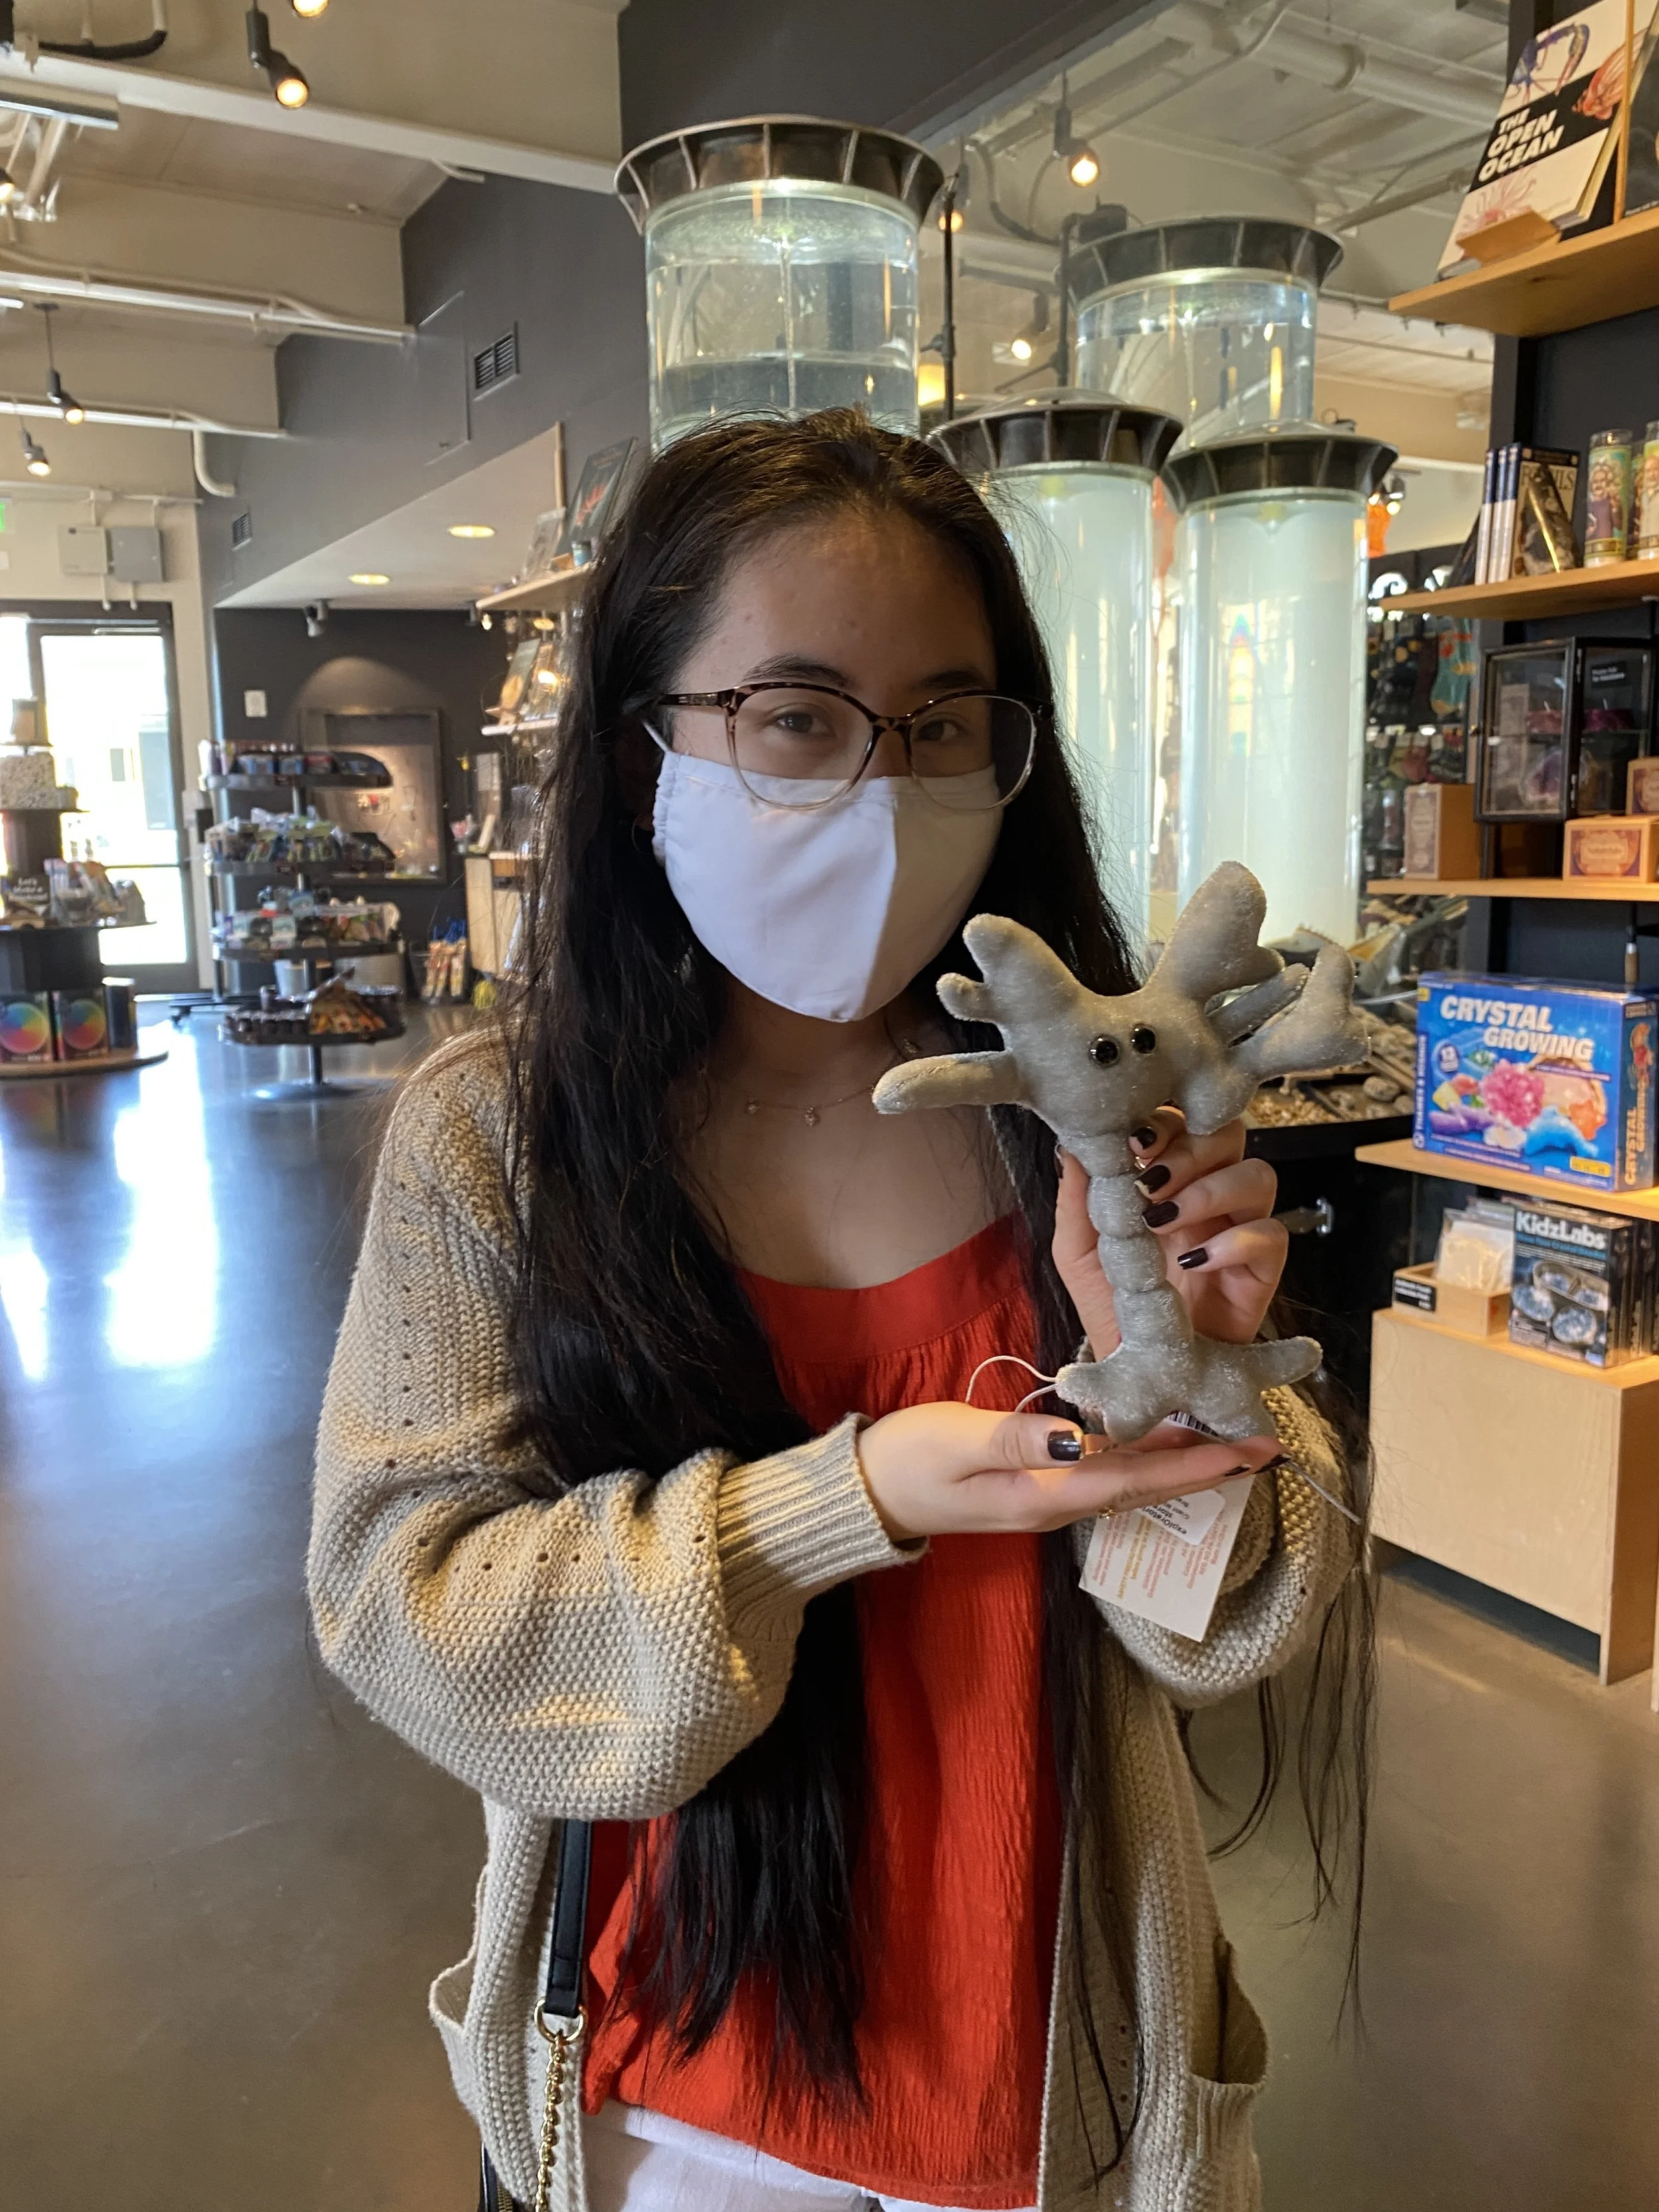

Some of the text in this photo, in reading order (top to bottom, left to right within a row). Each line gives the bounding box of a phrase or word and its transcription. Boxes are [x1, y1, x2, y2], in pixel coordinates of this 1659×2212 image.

[1487, 109, 1557, 159] OPEN
[1498, 108, 1530, 135] THE
[1478, 125, 1565, 182] OCEAN
[1522, 465, 1574, 489] FOILS
[1440, 995, 1553, 1033] CRYSTAL
[1482, 1026, 1595, 1061] GROWING
[1624, 1106, 1637, 1185] CRYSTAL
[1516, 1210, 1606, 1250] KidzLabs
[1141, 1506, 1187, 1534] explOratori
